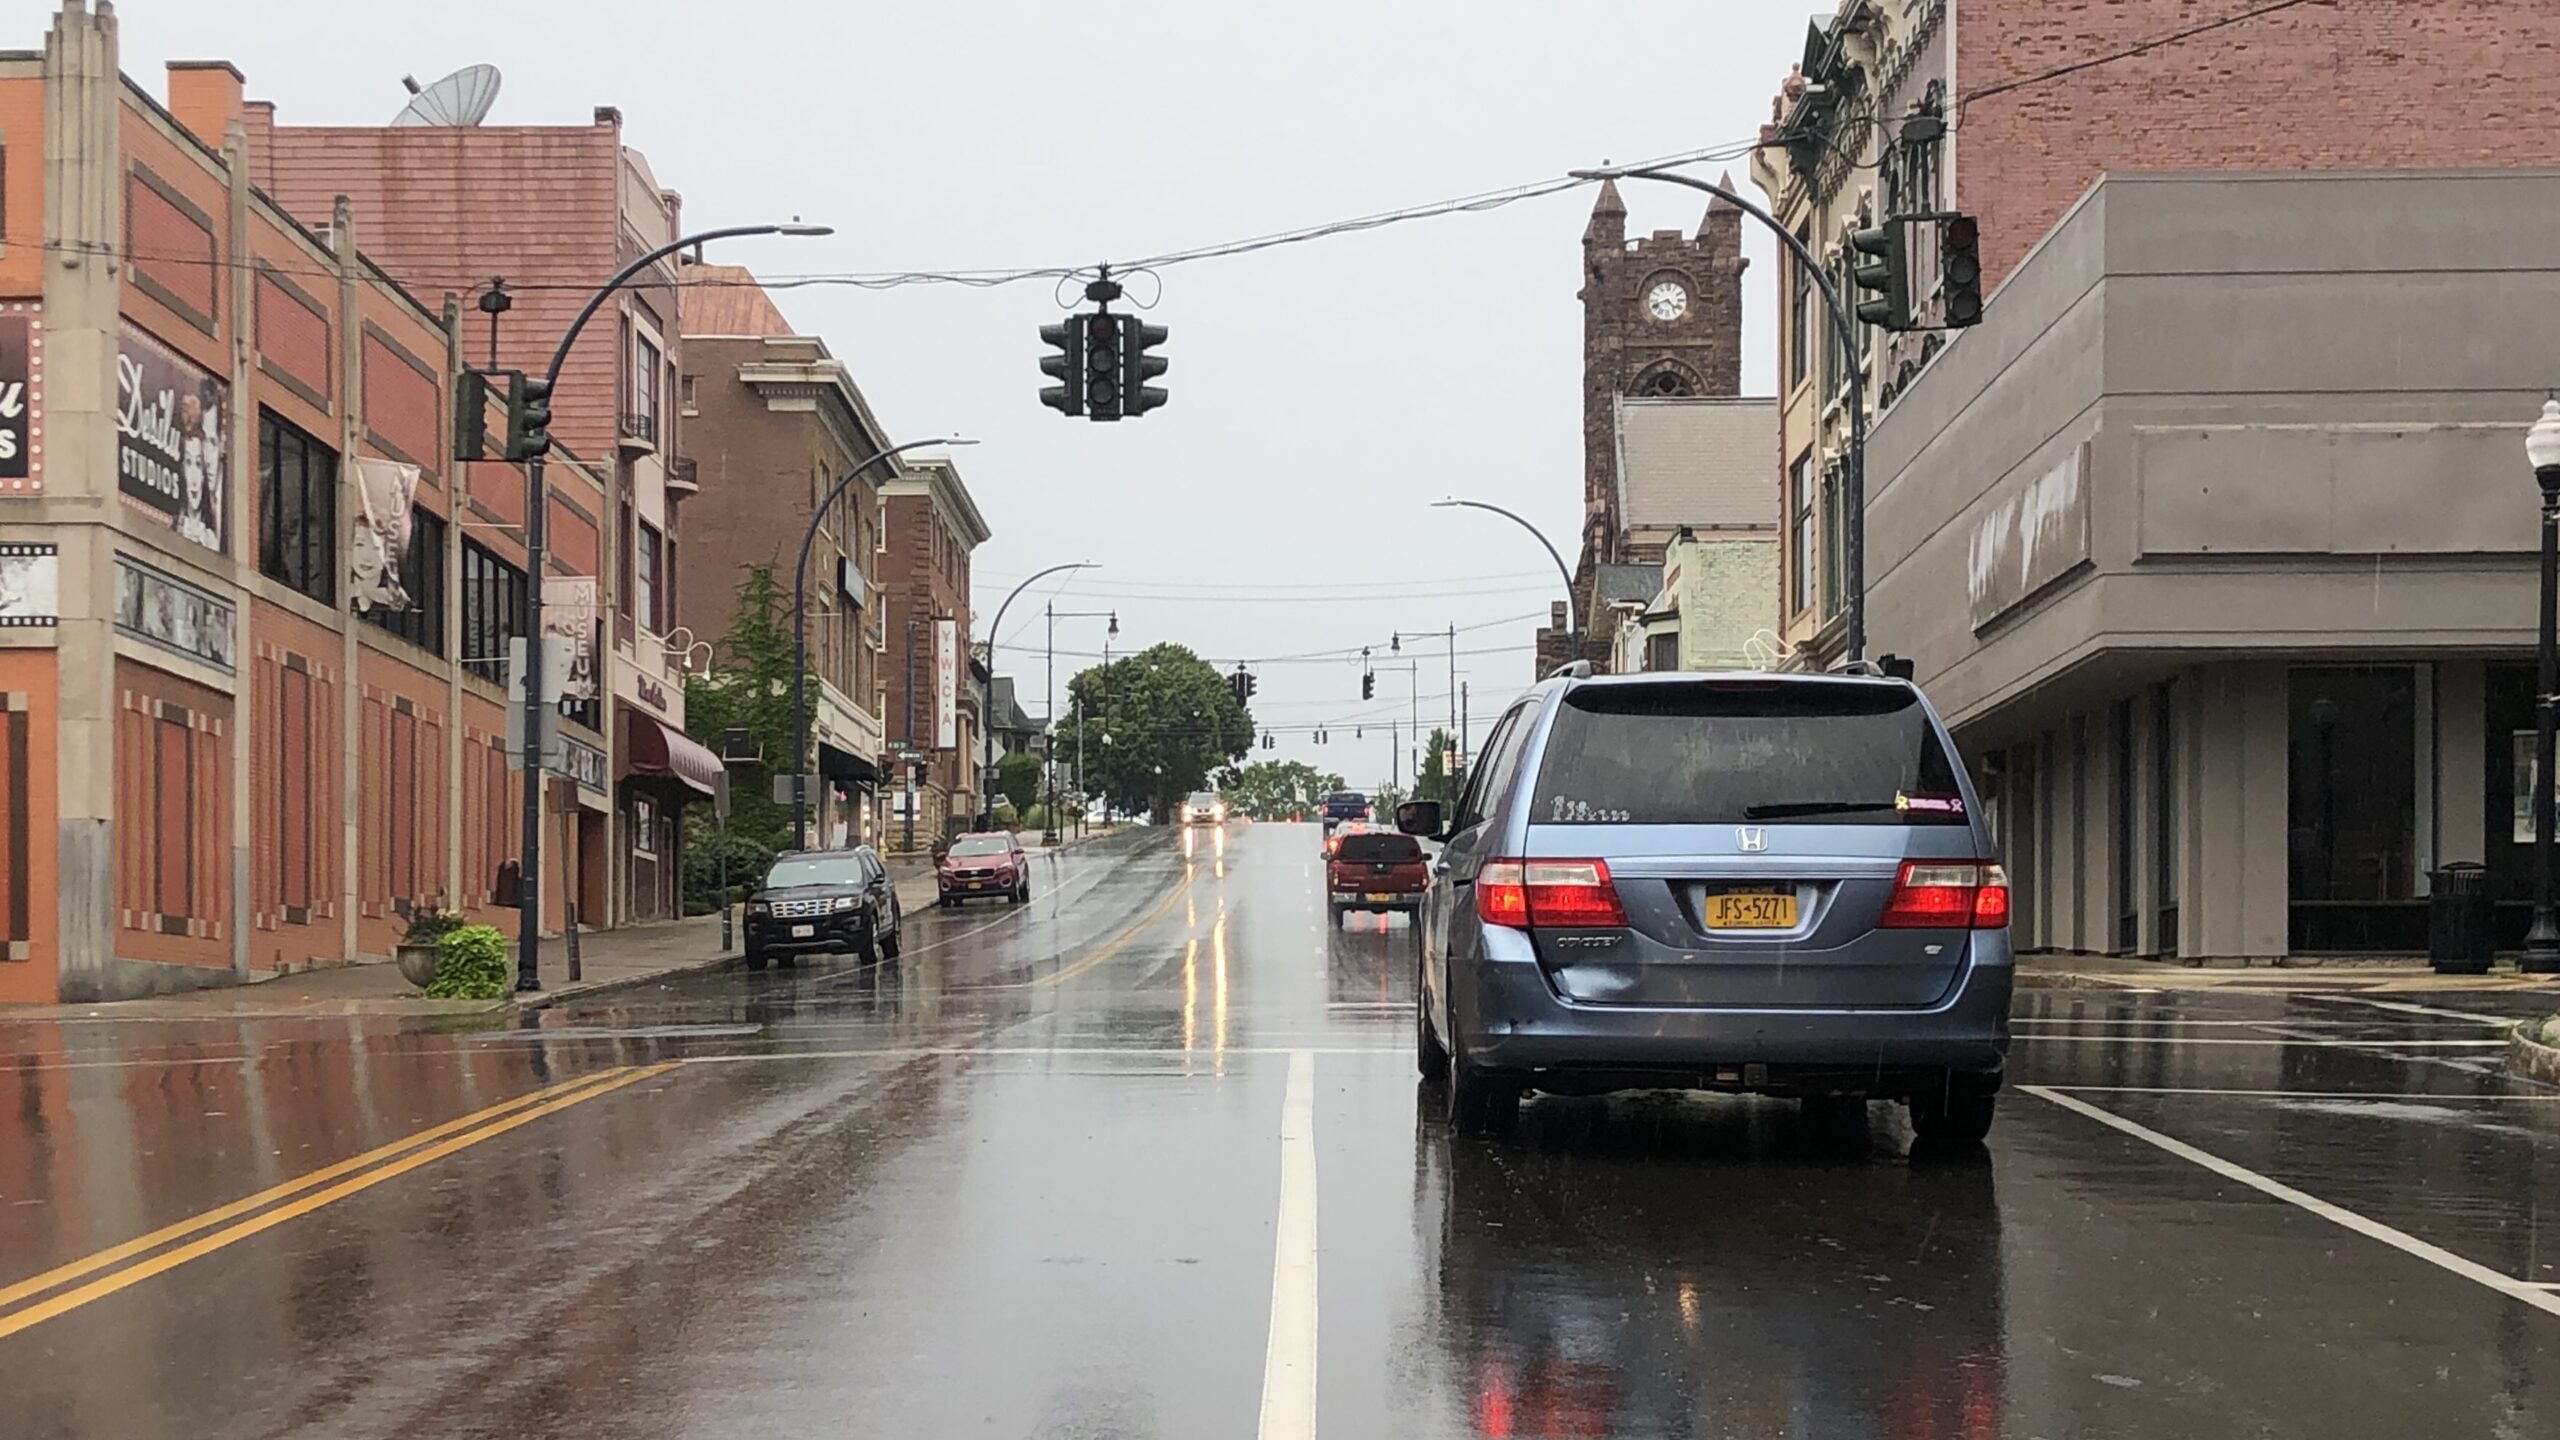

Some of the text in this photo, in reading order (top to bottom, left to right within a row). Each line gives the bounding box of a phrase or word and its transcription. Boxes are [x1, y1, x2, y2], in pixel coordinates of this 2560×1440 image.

[117, 353, 182, 462] Desilu
[122, 445, 181, 500] STUDIOS
[573, 583, 598, 700] MUSEUM
